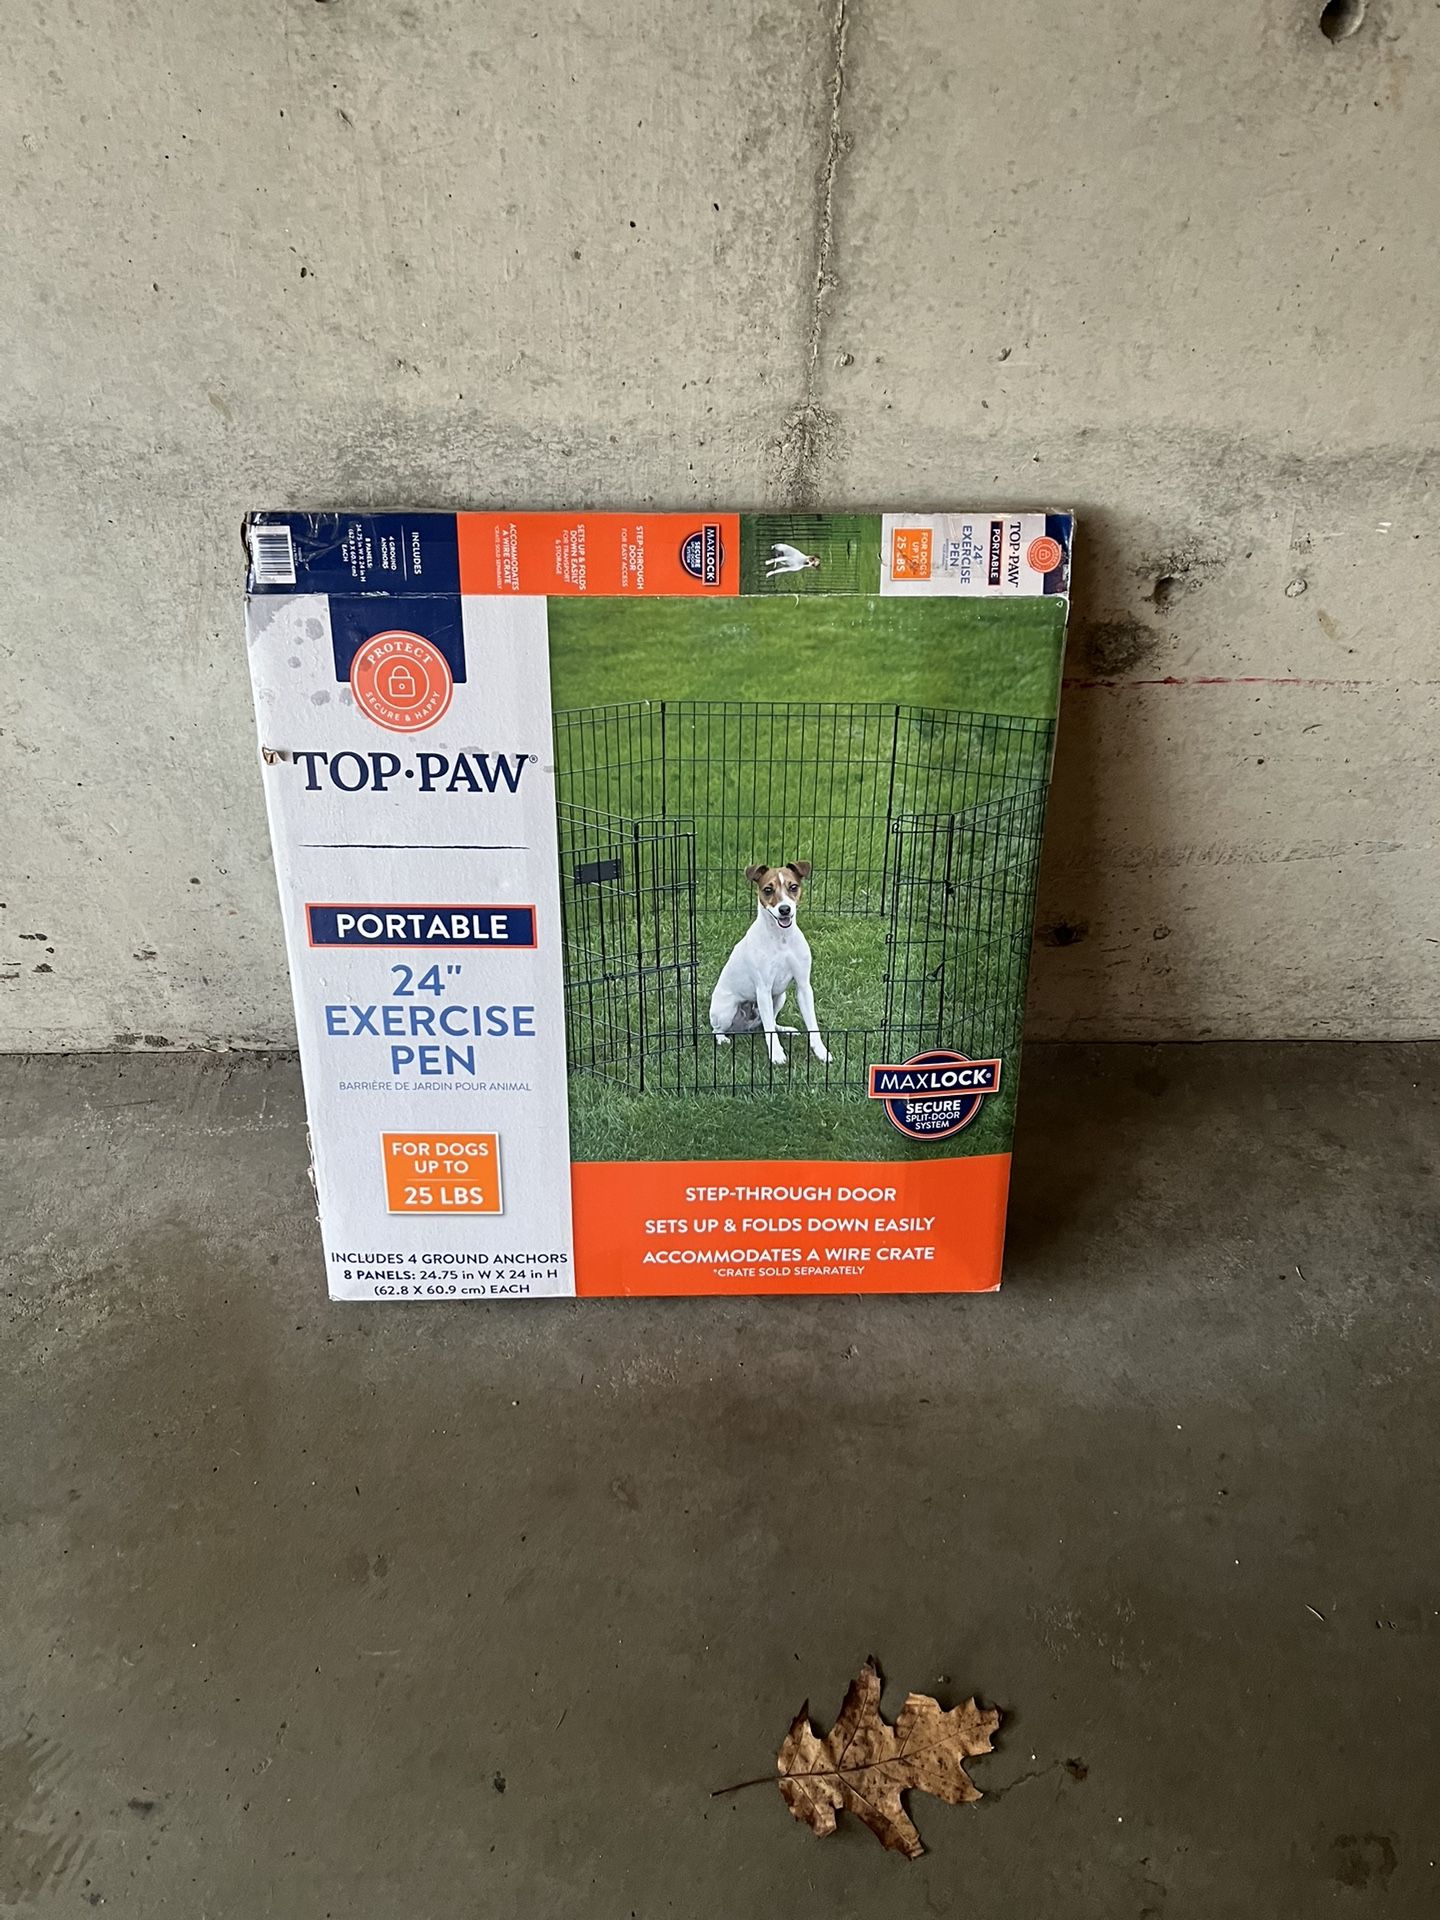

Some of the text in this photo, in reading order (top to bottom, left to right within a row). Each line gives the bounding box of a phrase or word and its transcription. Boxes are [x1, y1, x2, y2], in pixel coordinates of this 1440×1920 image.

[577, 524, 586, 543] SETS
[411, 532, 422, 575] INCLUDES
[509, 523, 519, 591] ACCOMMODATES
[570, 530, 579, 585] DOWN EASILY
[577, 544, 586, 556] UP
[629, 544, 637, 571] DOOR
[950, 542, 960, 567] PEN
[960, 525, 972, 584] EXERCISE
[990, 528, 1000, 579] PORTABLE
[503, 558, 511, 584] CRATE
[578, 564, 586, 591] FOLDS
[367, 641, 433, 665] PROTECT
[365, 690, 440, 722] SECURE & HAPPY
[336, 913, 509, 940] PORTABLE
[391, 964, 462, 997] 24"
[325, 1005, 536, 1037] EXERCISE
[390, 1045, 476, 1076] PEN
[339, 1079, 532, 1091] BARRIÈRE DE JARDIN POUR ANIMAL
[906, 1099, 961, 1114] SECURE
[905, 1111, 960, 1123] SPLIT-DOOR
[915, 1120, 950, 1130] SYSTEM
[391, 1142, 489, 1156] FOR DOGS
[414, 1160, 469, 1174] UP TO
[404, 1186, 484, 1206] 25 LBS
[685, 1186, 897, 1202] STEP-THROUGH DOOR
[645, 1216, 936, 1235] SETS UP & FOLDS DOWN EASILY
[331, 1252, 568, 1265] INCLUDES 4 GROUND ANCHORS
[643, 1246, 935, 1265] ACCOMMODATES A WIRE CRATE
[343, 1268, 558, 1280] 8 PANELS: 24.75 in W X 24 in H
[758, 1266, 790, 1277] SOLD
[793, 1265, 865, 1277] SEPARATELY
[374, 1284, 530, 1297] (62.8 X 60.9 cm) EACH
